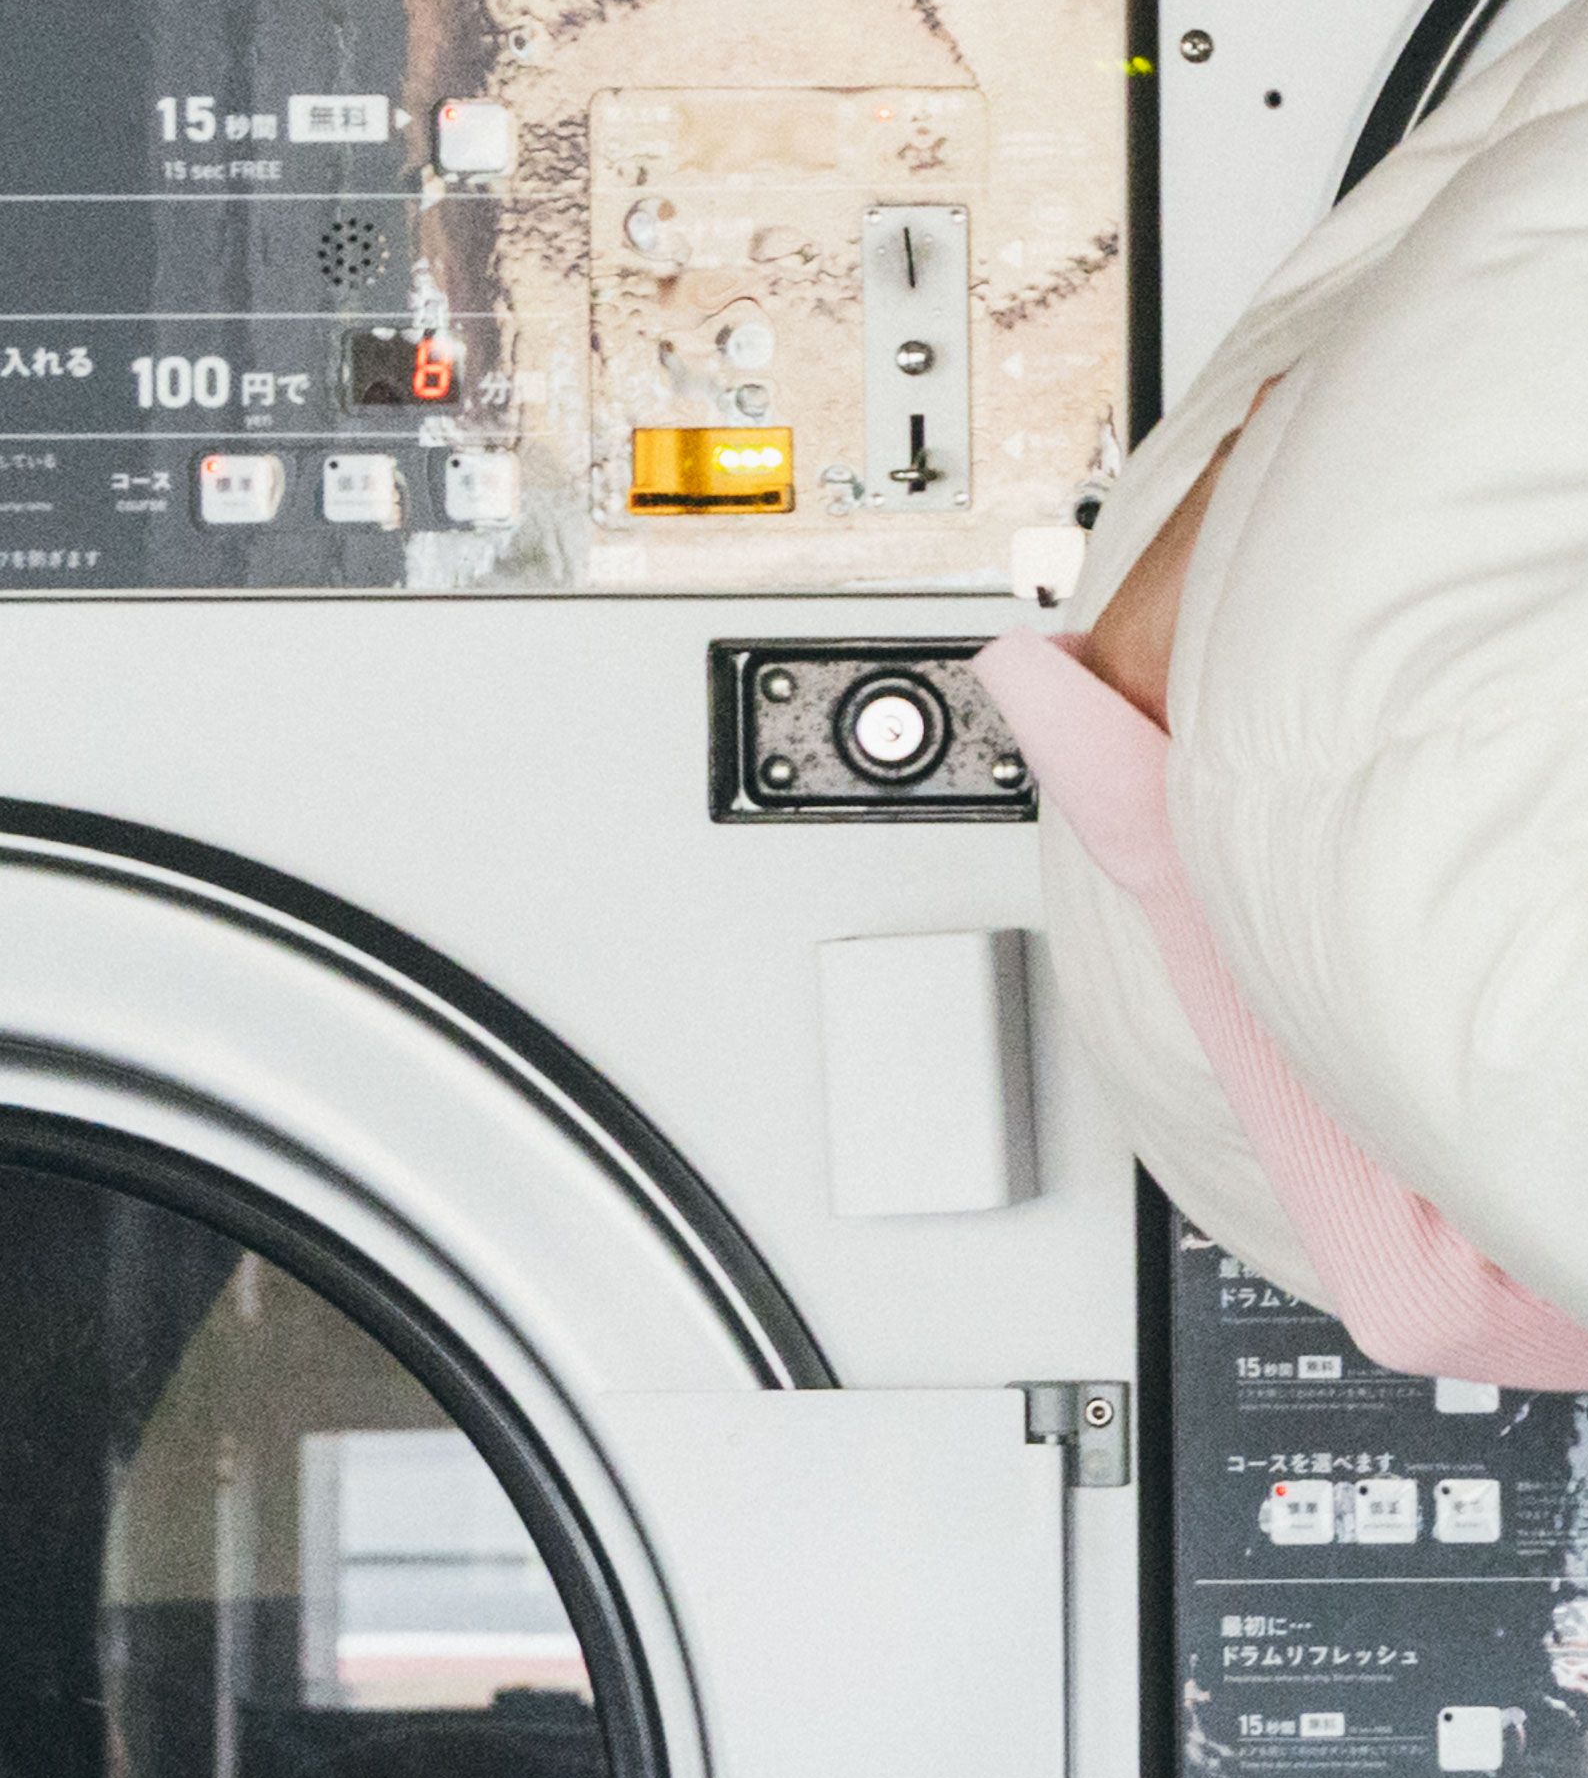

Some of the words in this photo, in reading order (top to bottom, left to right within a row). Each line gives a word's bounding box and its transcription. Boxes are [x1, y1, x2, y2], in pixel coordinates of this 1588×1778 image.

[164, 161, 187, 181] 15
[229, 161, 283, 180] FREE
[110, 471, 172, 491] コース
[1228, 1453, 1397, 1476] コースを選べます
[1224, 1646, 1417, 1666] ドラムリフレッシュ
